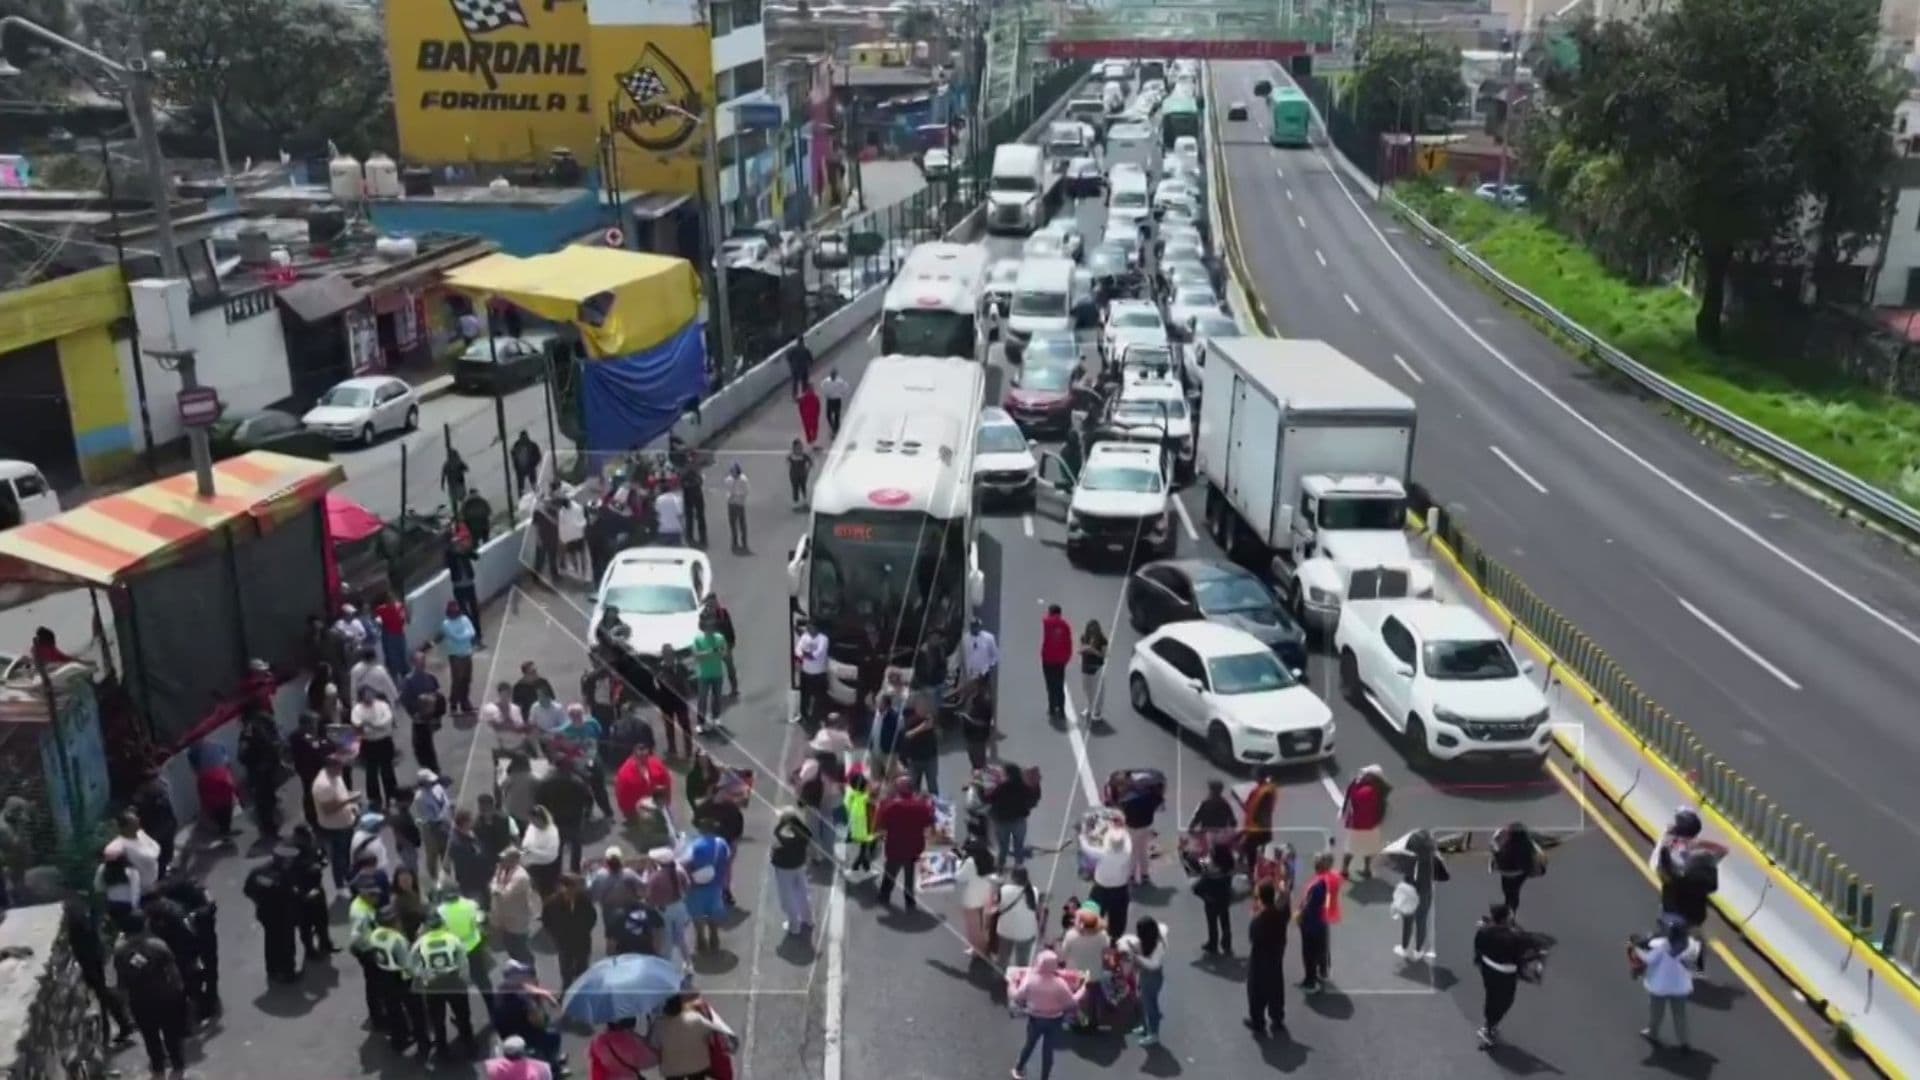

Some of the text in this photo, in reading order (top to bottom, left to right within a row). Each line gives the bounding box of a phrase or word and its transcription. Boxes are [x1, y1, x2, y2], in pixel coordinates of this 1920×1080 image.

[417, 40, 587, 75] BARDAHL
[421, 91, 591, 112] FORMULA 1
